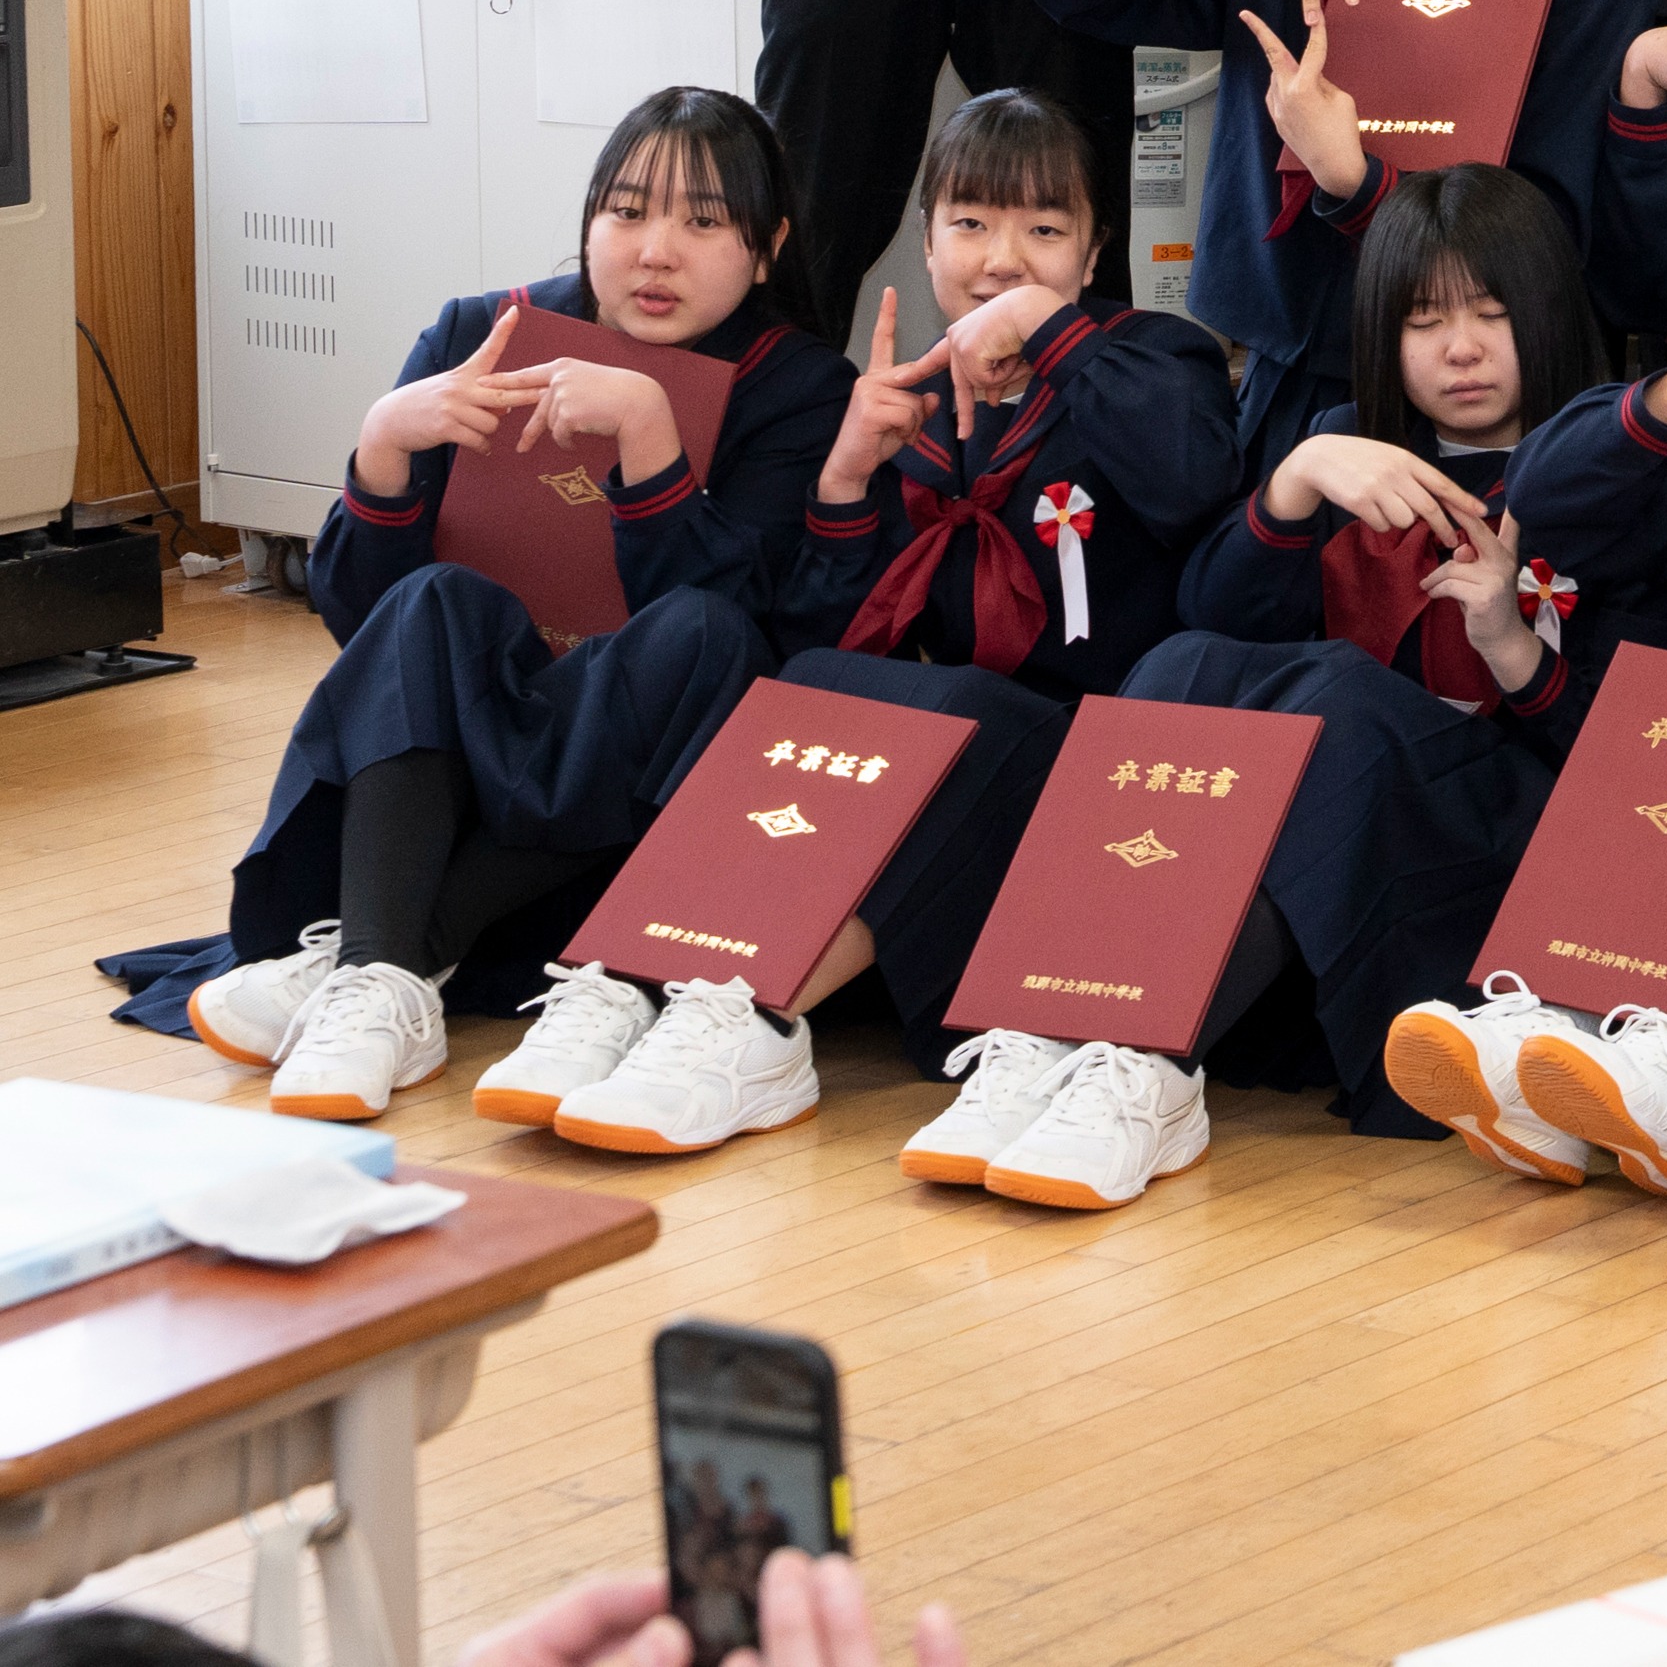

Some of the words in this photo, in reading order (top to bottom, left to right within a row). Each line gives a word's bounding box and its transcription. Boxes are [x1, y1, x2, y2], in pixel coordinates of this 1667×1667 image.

[1145, 75, 1180, 84] スチーム式
[763, 739, 892, 784] 卒業証書
[1107, 759, 1241, 800] 卒業証書
